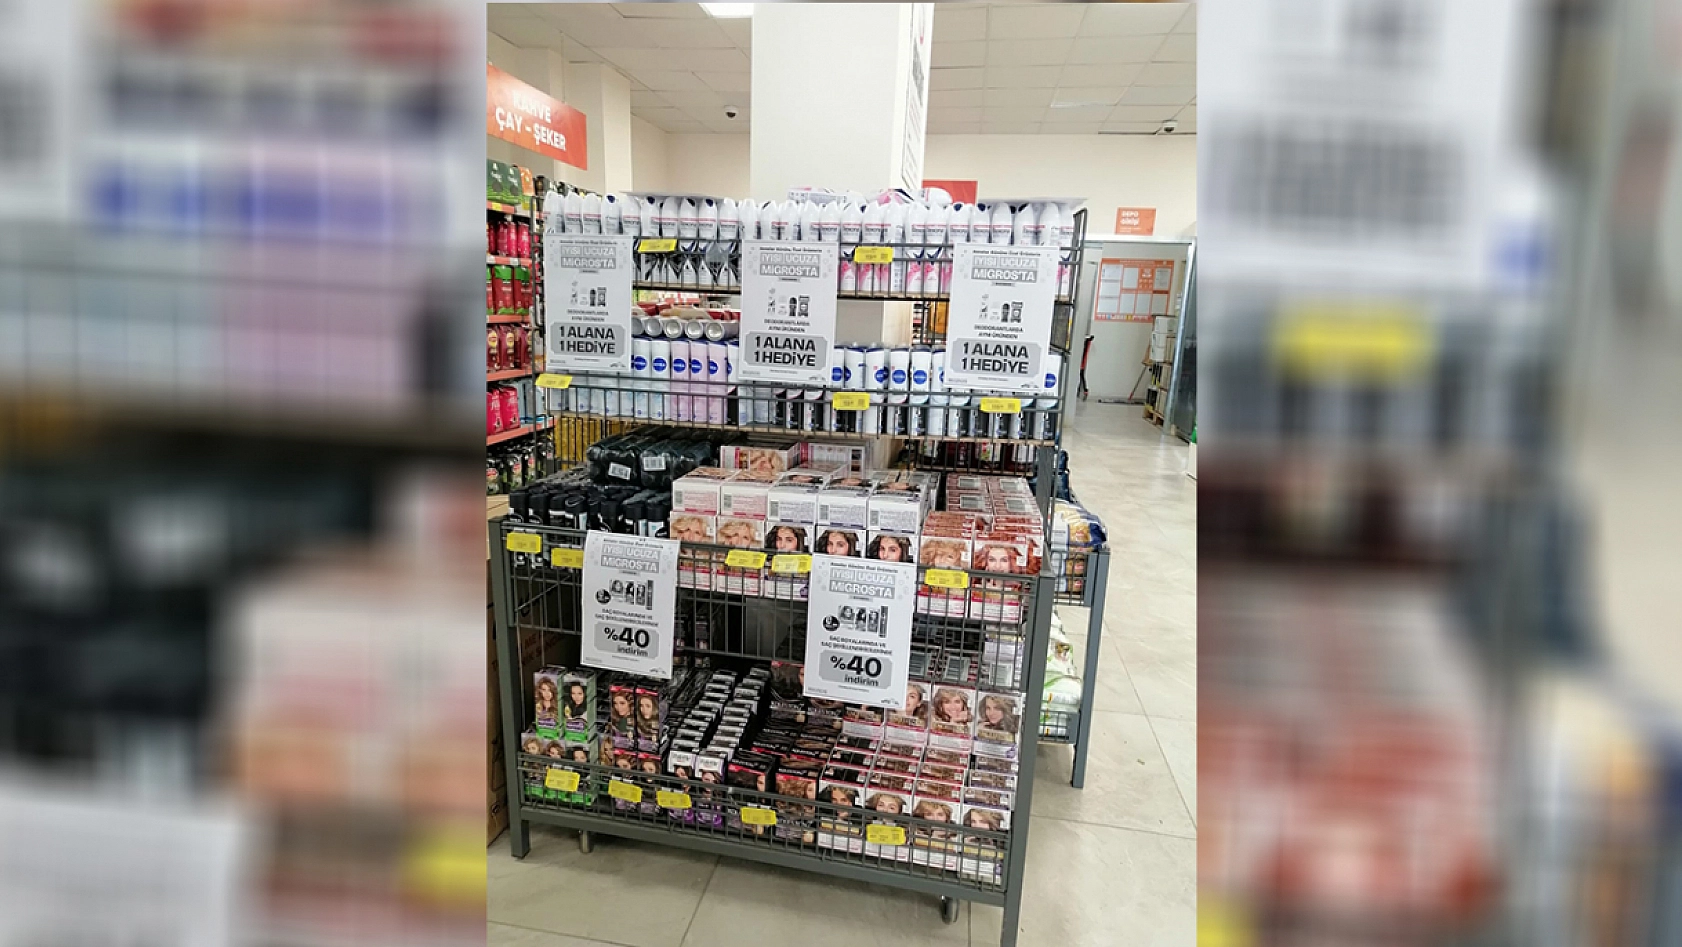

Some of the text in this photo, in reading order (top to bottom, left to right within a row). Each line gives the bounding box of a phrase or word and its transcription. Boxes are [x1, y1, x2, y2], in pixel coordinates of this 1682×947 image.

[495, 107, 522, 133] ÇAY
[533, 122, 566, 151] ŞEKER
[560, 326, 615, 340] 1 ALANA
[560, 341, 564, 351] 1
[755, 337, 815, 352] 1 ALANA
[964, 342, 1029, 358] 1 ALANA
[754, 351, 759, 362] 1
[962, 358, 967, 370] 1
[604, 627, 649, 648] %40
[618, 645, 648, 657] indirim
[830, 655, 882, 678] %40
[844, 674, 878, 686] indirim
